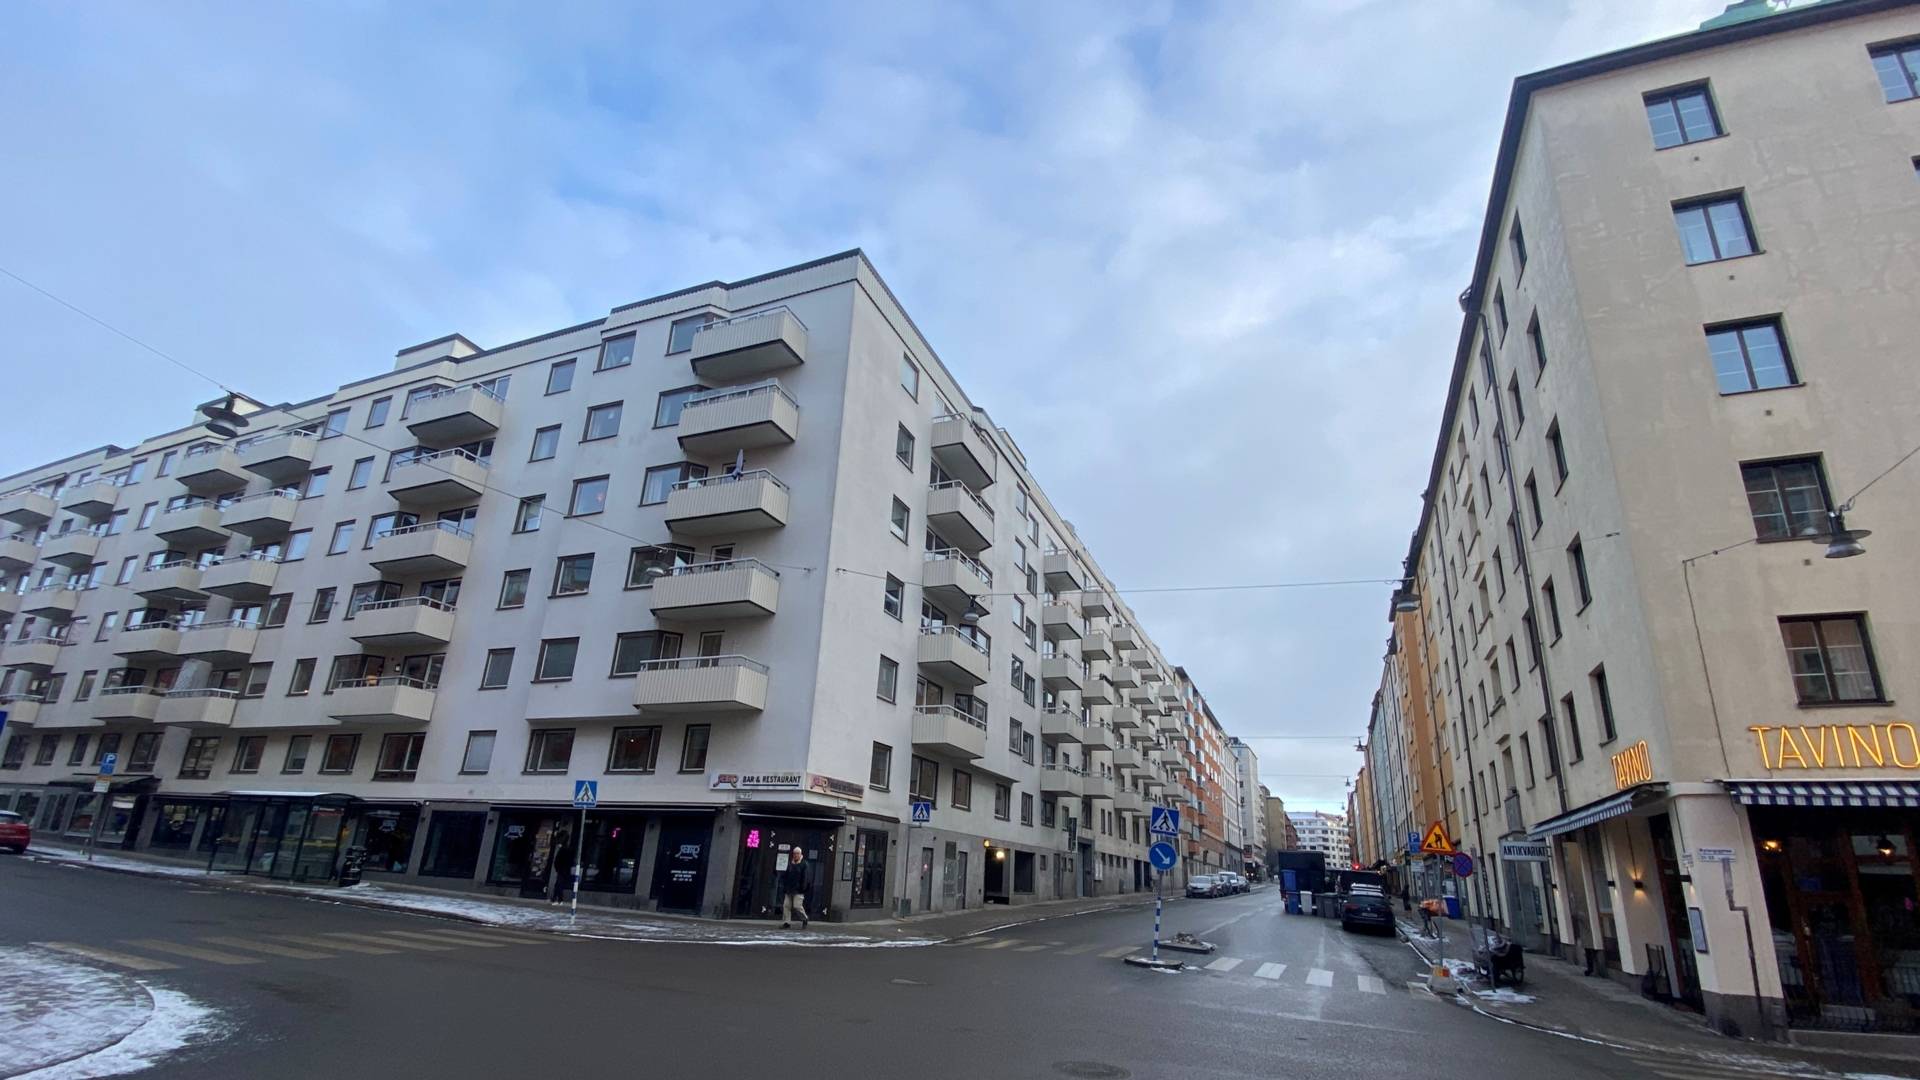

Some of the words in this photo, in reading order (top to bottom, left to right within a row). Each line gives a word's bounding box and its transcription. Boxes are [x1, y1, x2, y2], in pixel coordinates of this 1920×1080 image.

[1748, 721, 1920, 769] TAVINO
[106, 754, 116, 763] P
[1611, 739, 1653, 790] TAVINO
[742, 775, 755, 784] BAR
[756, 776, 761, 784] &
[762, 775, 802, 785] RESTAURANT
[1503, 845, 1546, 857] ANTIKVARIAT
